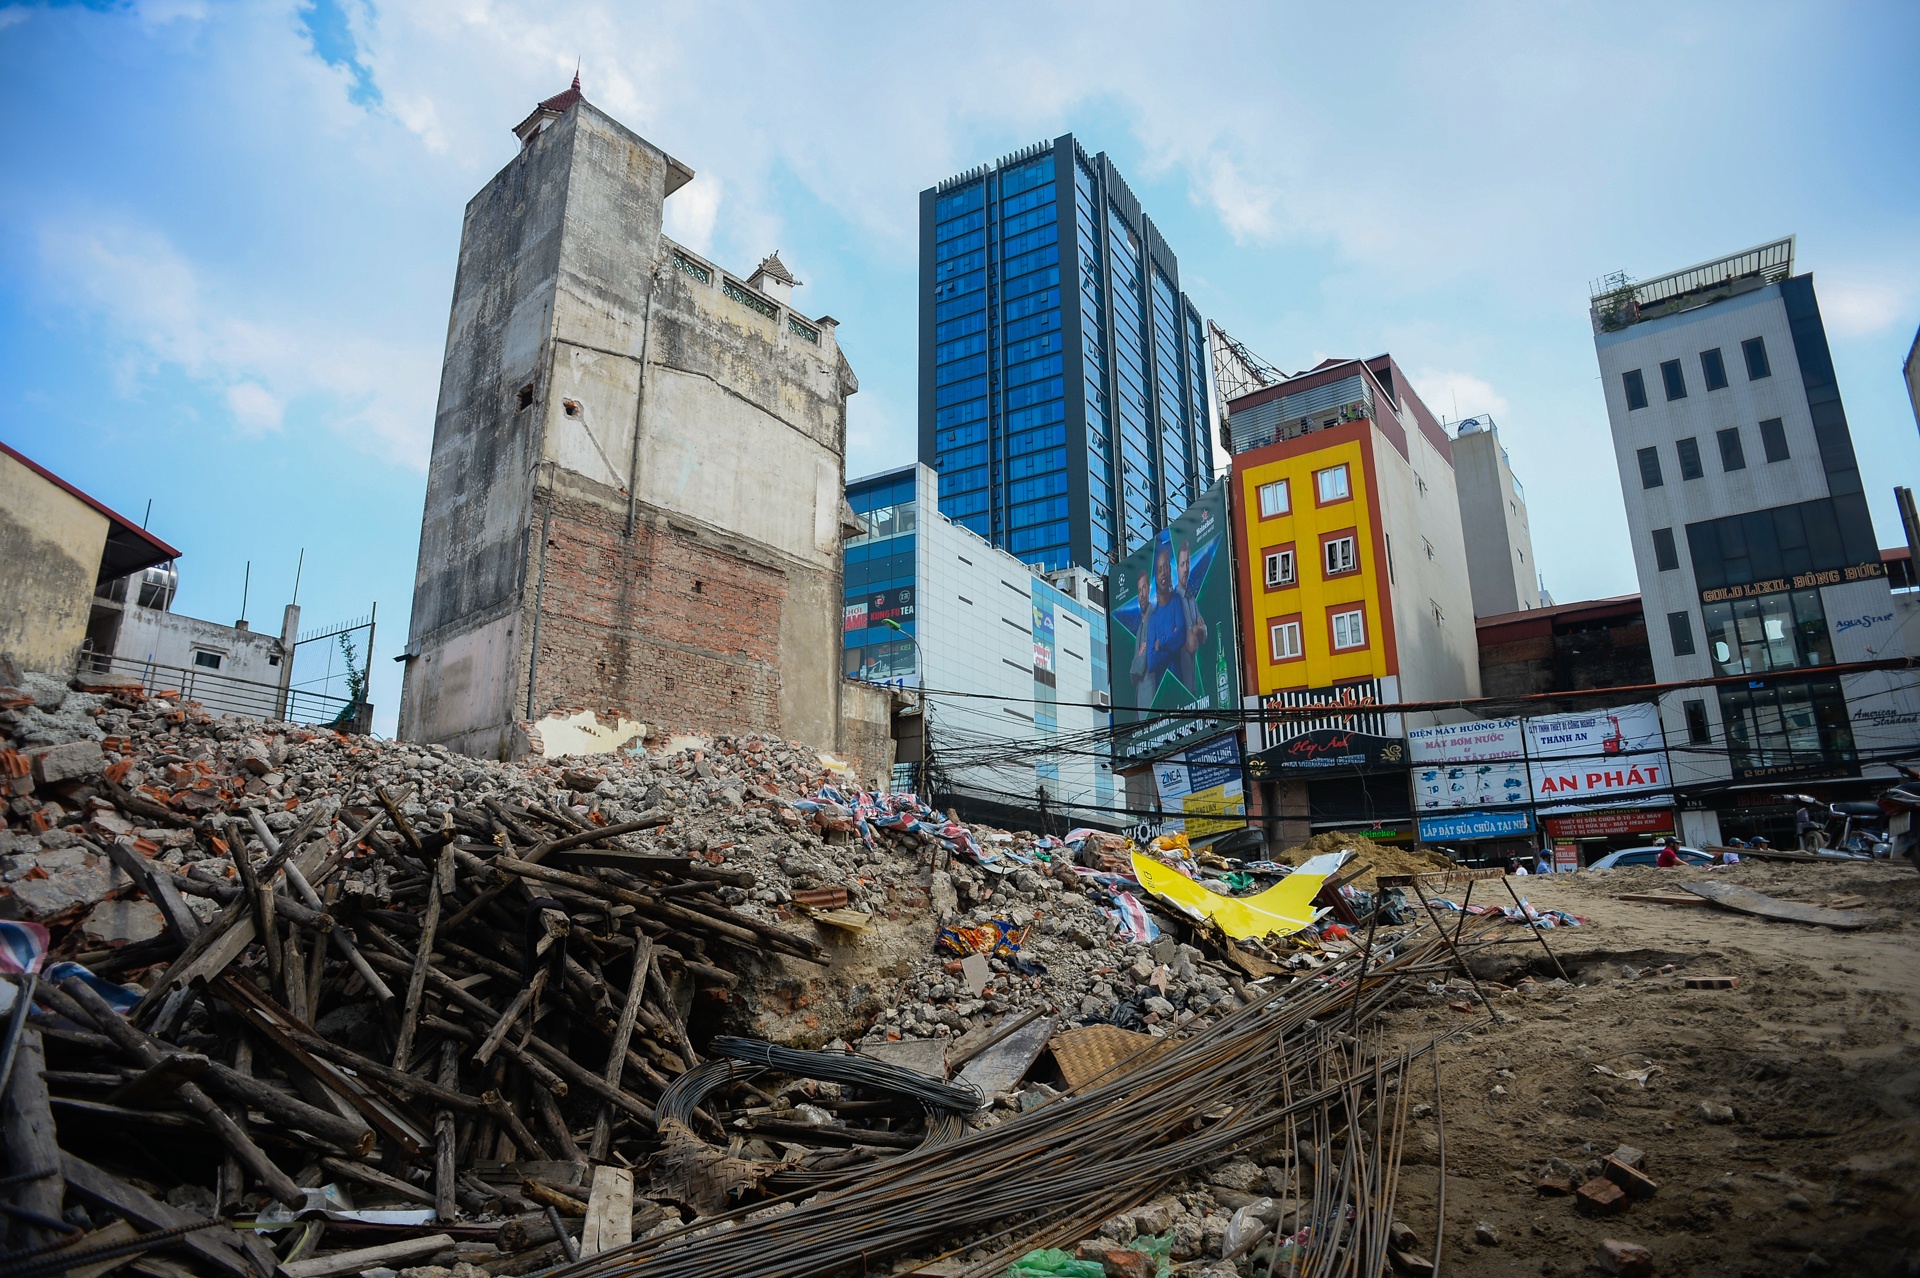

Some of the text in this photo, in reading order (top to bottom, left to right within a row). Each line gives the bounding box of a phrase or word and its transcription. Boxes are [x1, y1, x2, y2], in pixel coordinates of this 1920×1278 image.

[1703, 586, 1743, 602] GOLD
[1745, 579, 1790, 596] LIXIL
[870, 605, 914, 620] KUNG FU TEA
[1853, 708, 1897, 719] American
[1873, 714, 1918, 726] Standard
[1436, 726, 1457, 735] MÁY
[1425, 733, 1504, 749] MÁY BƠM NƯỚC
[1575, 733, 1588, 741] AN
[1541, 764, 1660, 793] AN PHÁT
[1497, 821, 1512, 833] TẠI
